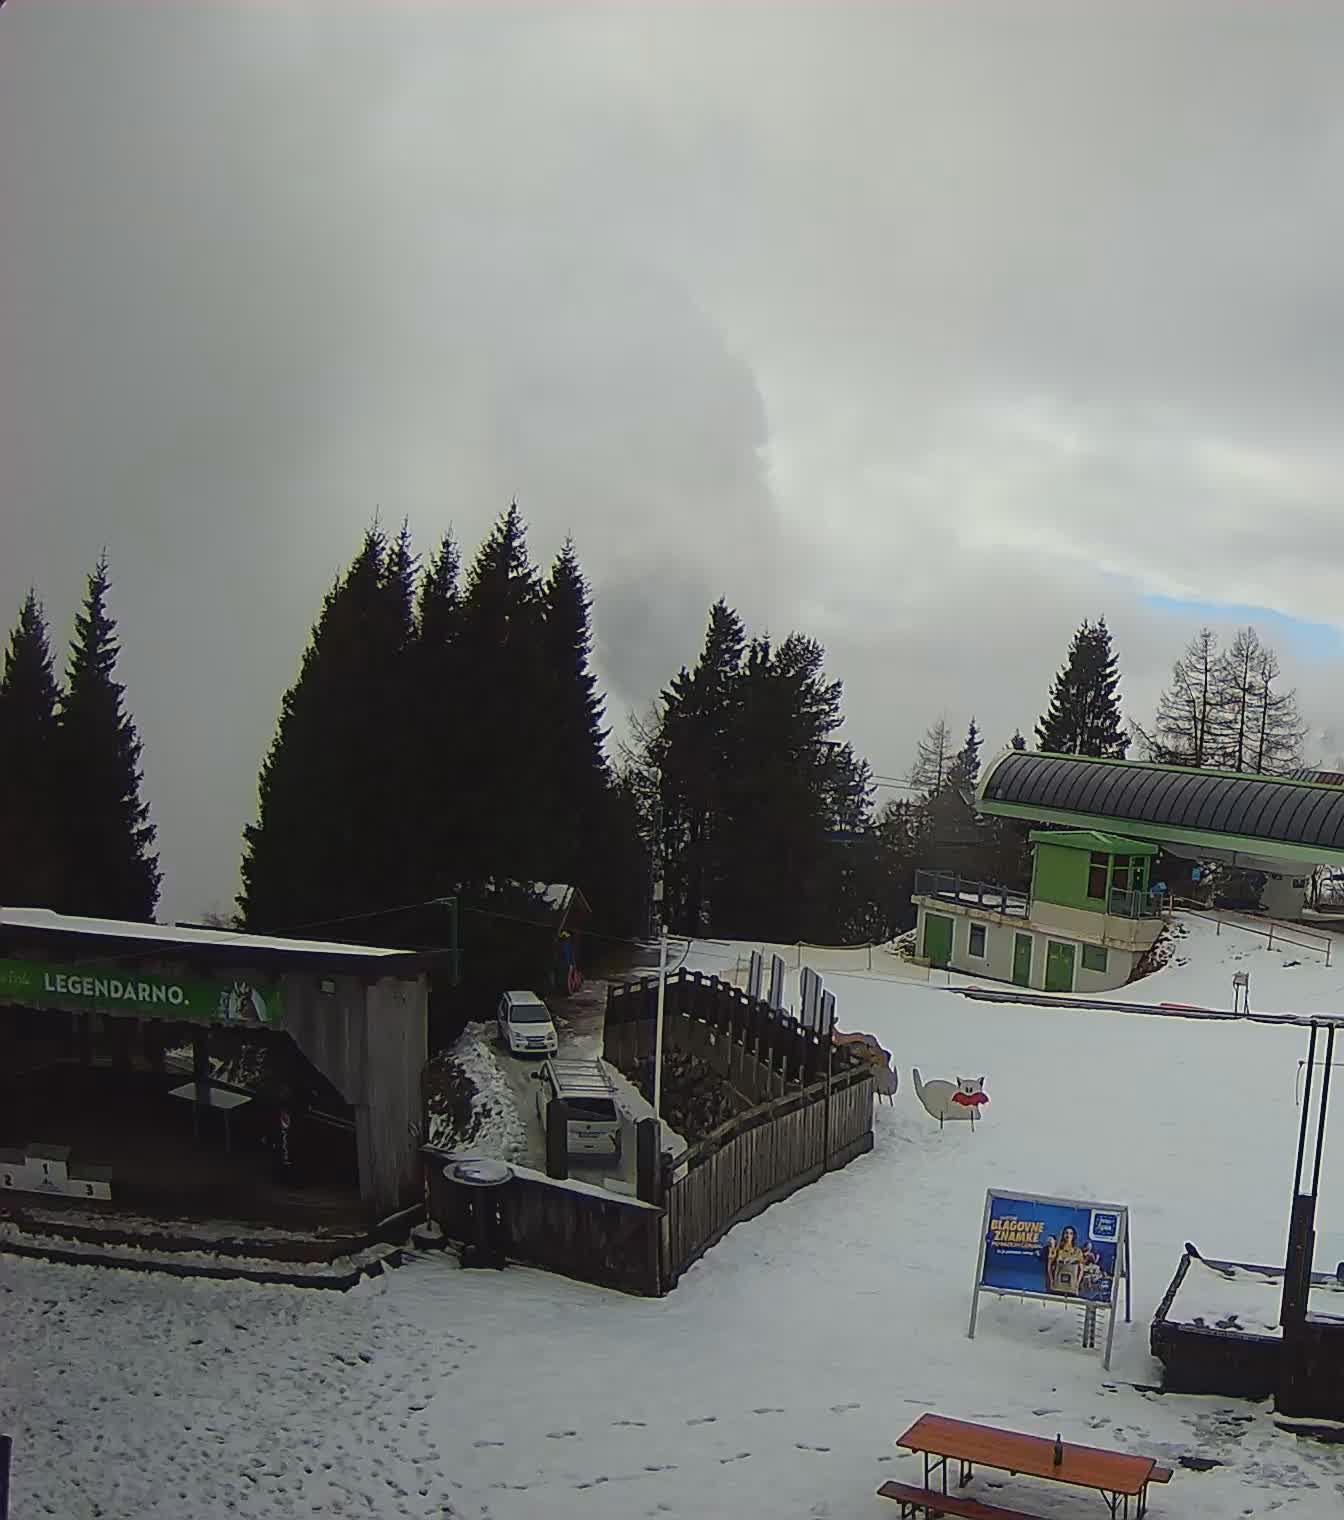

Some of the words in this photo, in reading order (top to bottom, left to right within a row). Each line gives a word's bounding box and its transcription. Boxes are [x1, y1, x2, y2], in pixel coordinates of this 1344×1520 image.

[43, 972, 191, 1006] LEGENDARNO.
[42, 1163, 49, 1175] 1
[4, 1174, 12, 1186] 2
[85, 1184, 94, 1196] 3
[991, 1219, 1045, 1233] BLAGOVNE
[994, 1231, 1040, 1243] ZNAMKE
